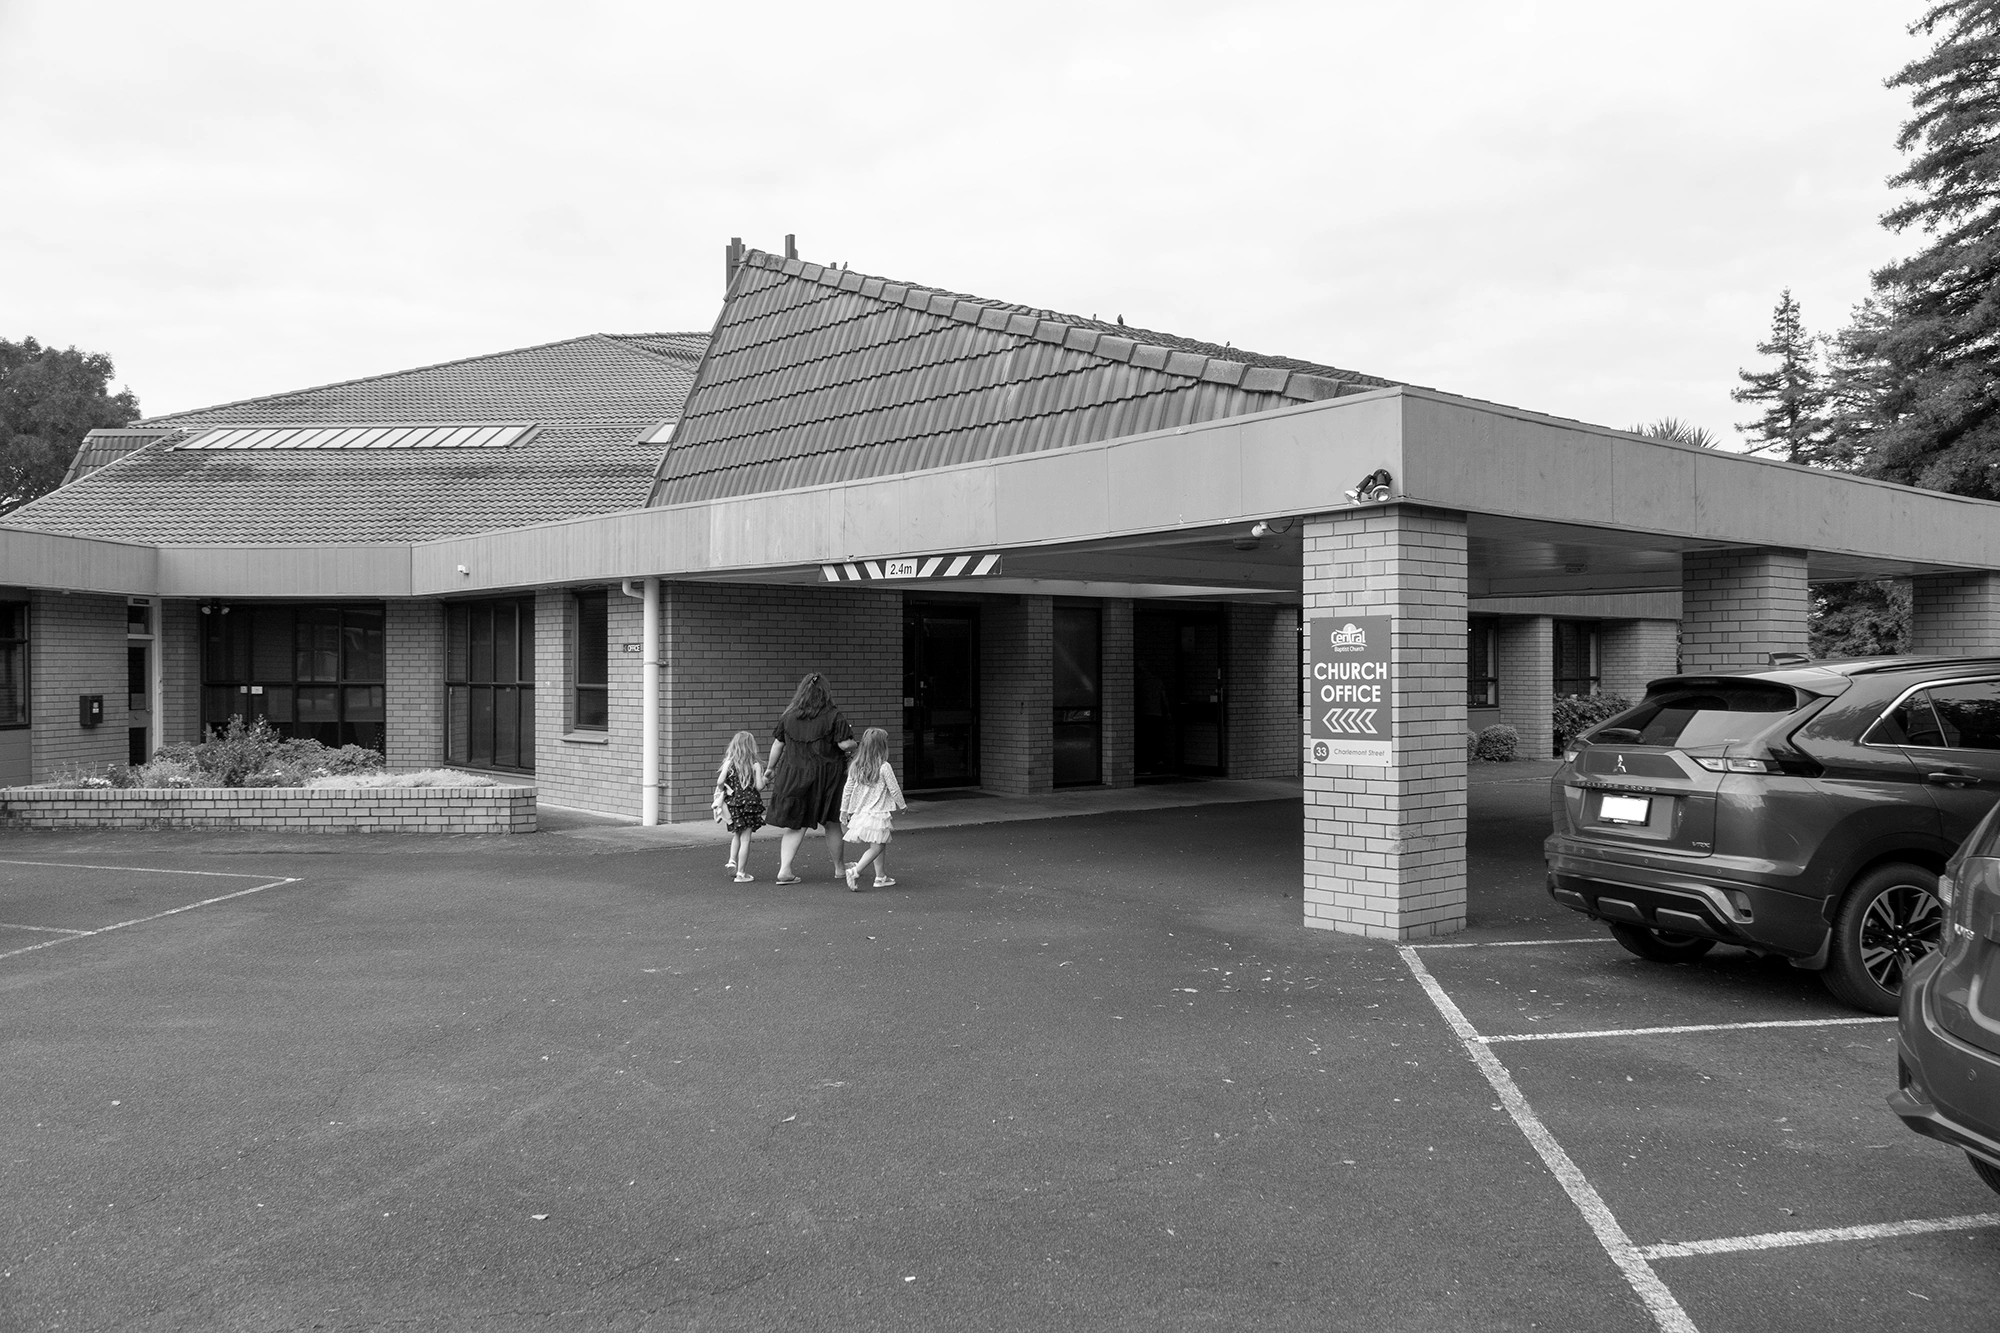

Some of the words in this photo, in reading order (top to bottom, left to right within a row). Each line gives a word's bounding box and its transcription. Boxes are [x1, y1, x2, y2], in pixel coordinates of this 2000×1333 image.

[890, 563, 913, 575] 2.4m
[1331, 629, 1367, 644] Central
[1334, 645, 1350, 653] Baptist
[1314, 662, 1388, 680] CHURCH
[1320, 684, 1381, 702] OFFICE
[1315, 746, 1327, 757] 33
[1333, 748, 1368, 756] Charlemont
[1368, 749, 1386, 757] Street
